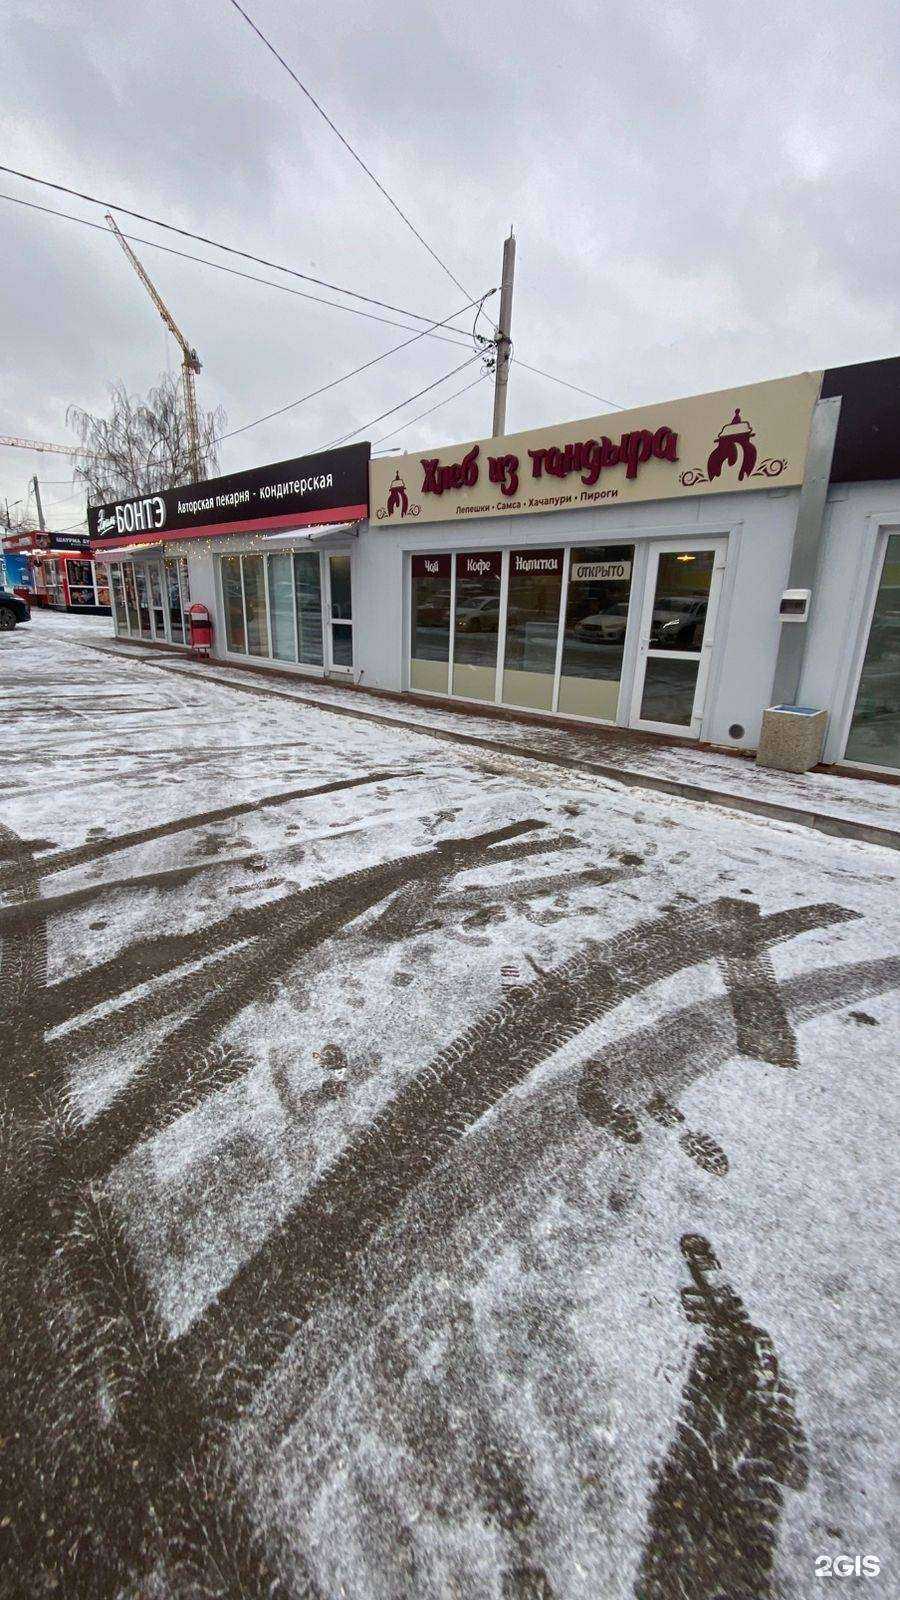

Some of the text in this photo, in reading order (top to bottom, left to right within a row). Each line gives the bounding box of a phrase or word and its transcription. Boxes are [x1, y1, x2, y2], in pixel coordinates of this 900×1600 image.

[420, 426, 679, 496] Хлеб из тандыра
[177, 473, 333, 514] Авторская пекарня кондитерская
[456, 489, 618, 515] Лепешки Самса Хачапури Пироги
[115, 497, 167, 533] БОНТЭ
[424, 560, 439, 576] Чай
[467, 558, 491, 575] Кофе
[516, 556, 558, 571] Напитки
[576, 568, 624, 579] ОТКРЫТО
